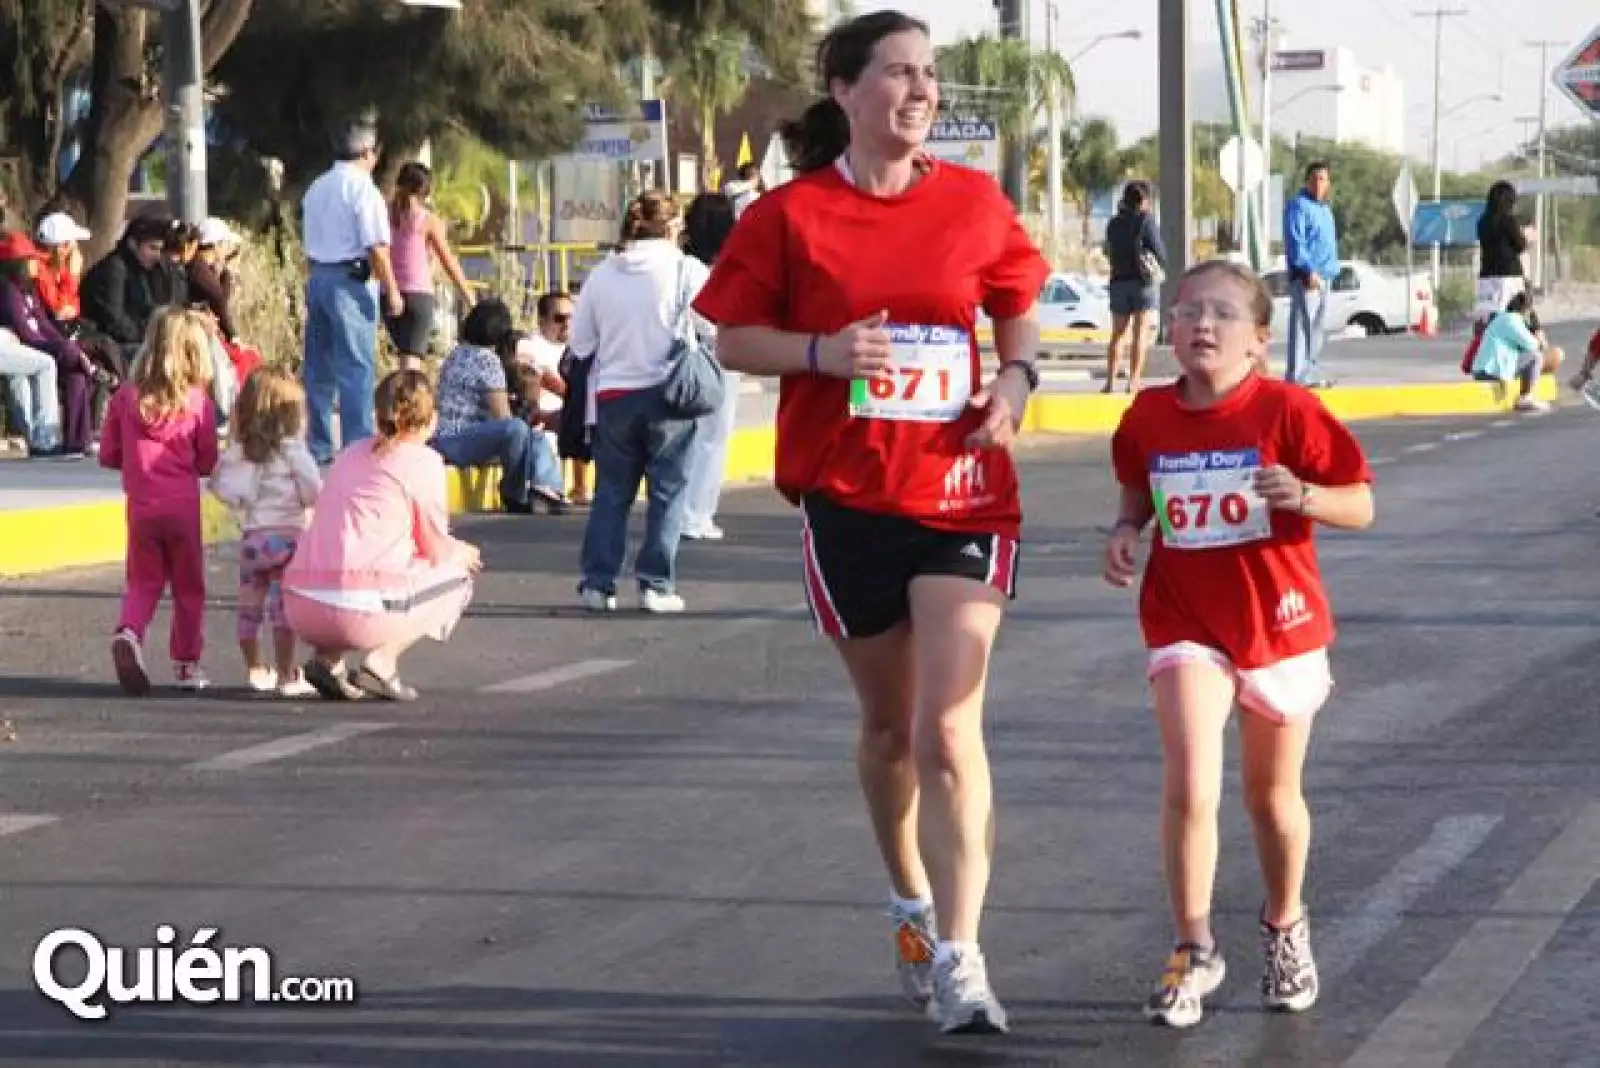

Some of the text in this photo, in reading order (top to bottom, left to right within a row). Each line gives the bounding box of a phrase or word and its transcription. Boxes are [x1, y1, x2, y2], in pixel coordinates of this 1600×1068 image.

[868, 366, 949, 401] 671
[1159, 451, 1247, 472] Family Day
[1166, 492, 1249, 531] 670
